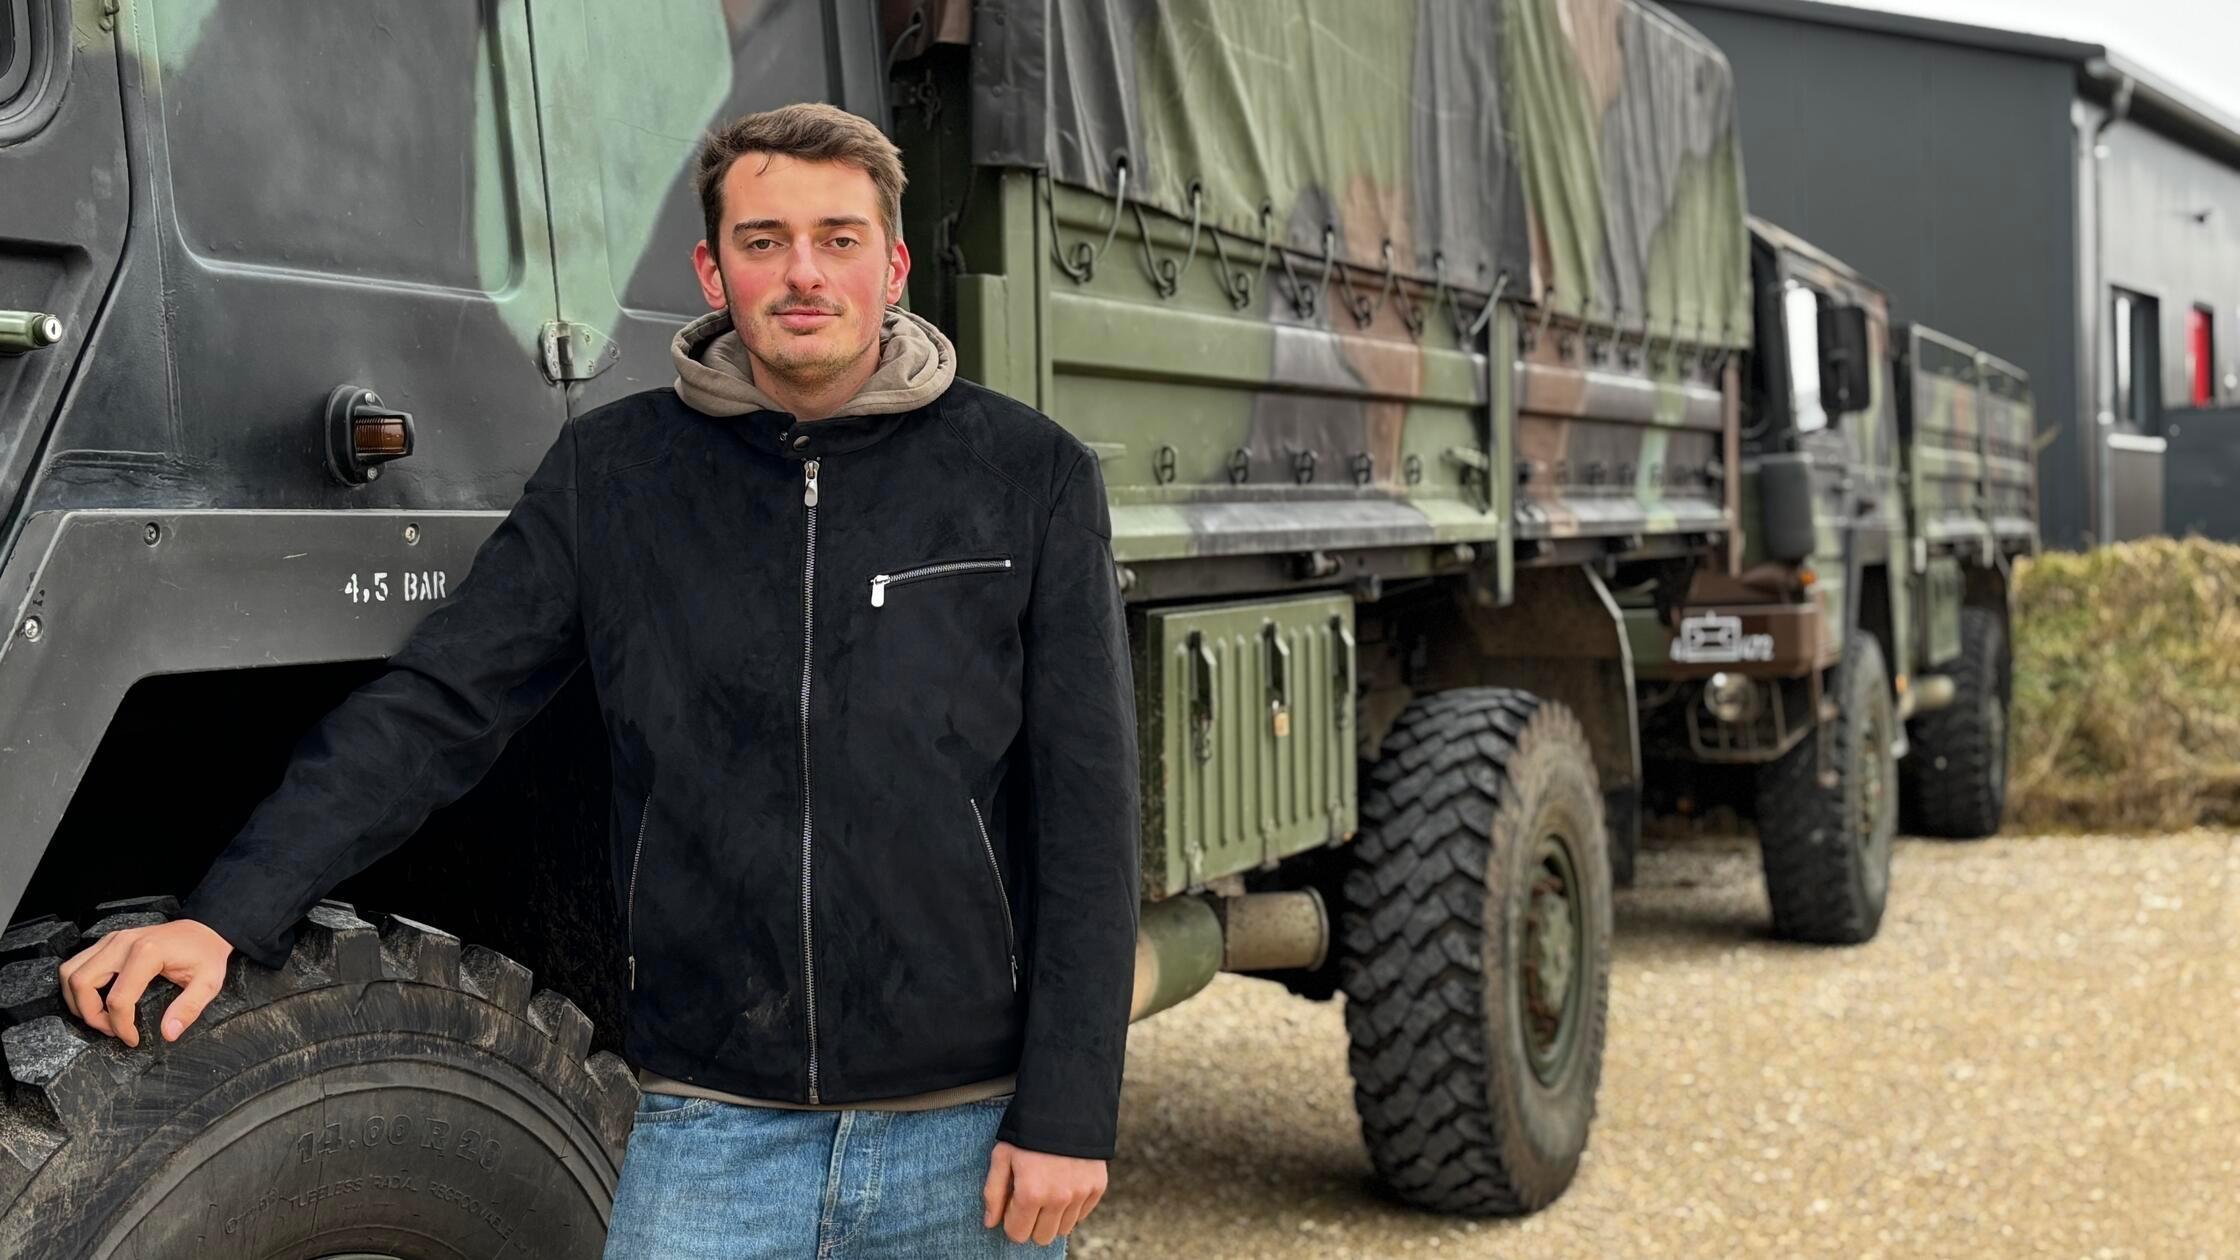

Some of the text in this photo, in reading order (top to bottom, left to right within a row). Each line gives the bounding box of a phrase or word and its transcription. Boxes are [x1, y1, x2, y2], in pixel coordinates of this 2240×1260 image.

[344, 571, 447, 603] 4,5 BAR
[297, 1114, 503, 1171] 14.00 R 20
[372, 1174, 417, 1193] RADAL
